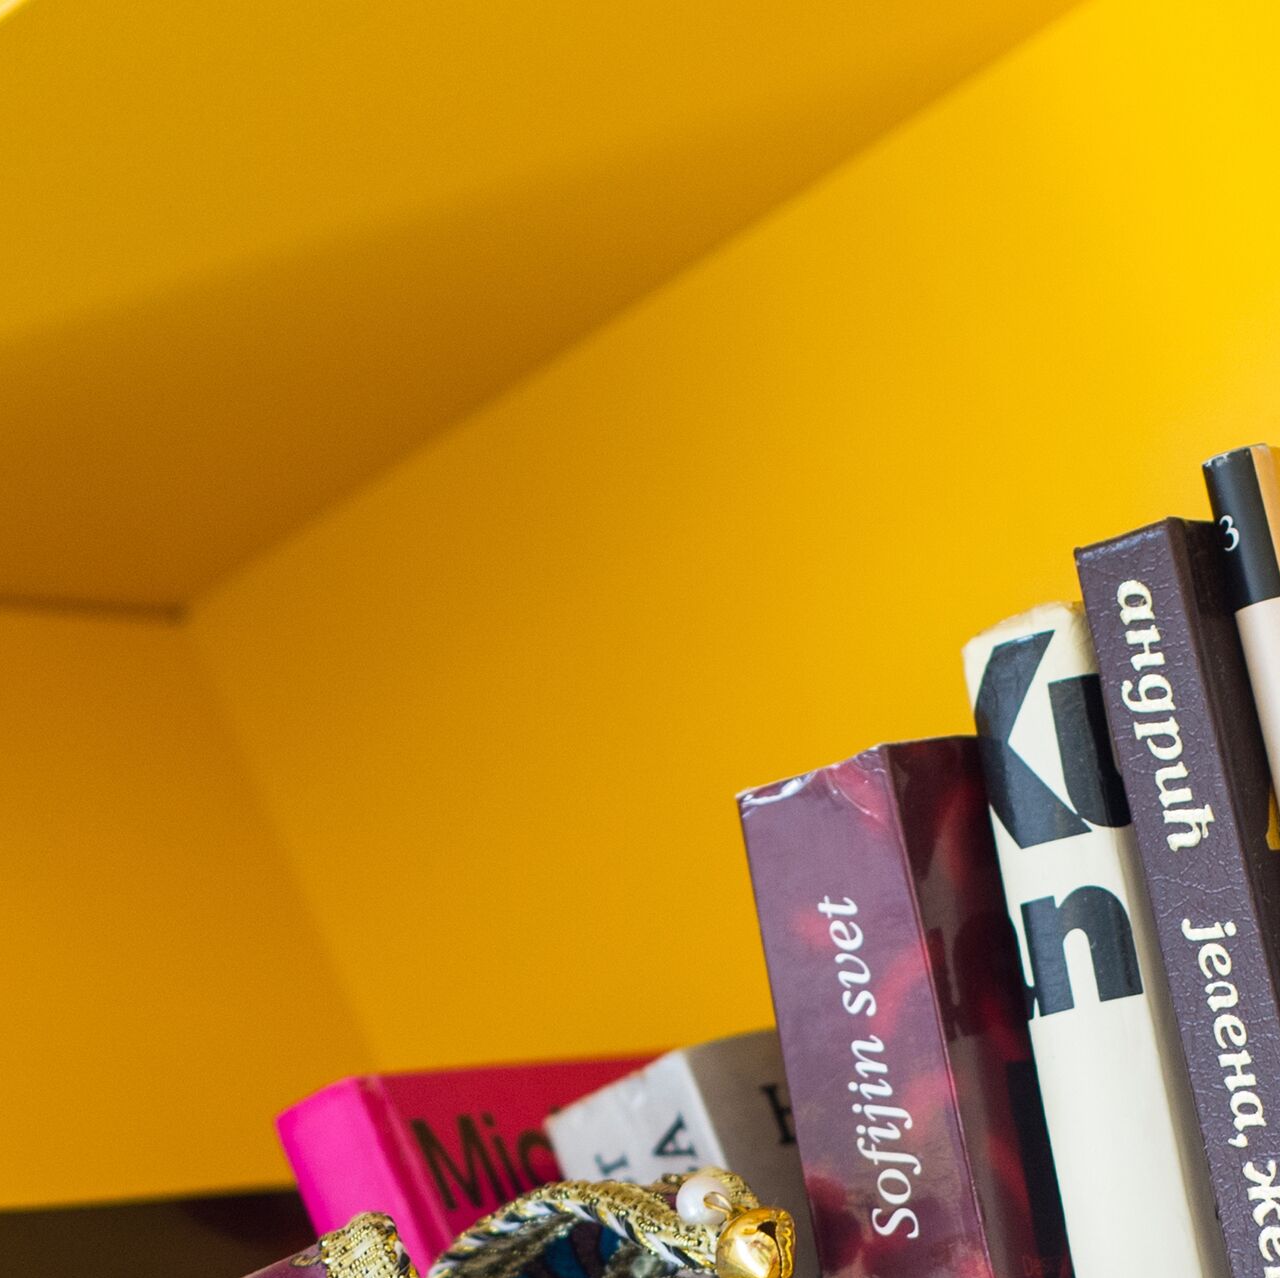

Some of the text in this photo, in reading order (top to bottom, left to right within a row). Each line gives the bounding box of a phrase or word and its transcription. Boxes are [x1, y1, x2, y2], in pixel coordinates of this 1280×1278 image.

[1219, 514, 1240, 552] 3
[1117, 579, 1215, 851] андрић
[818, 895, 921, 1240] Sofijin svet
